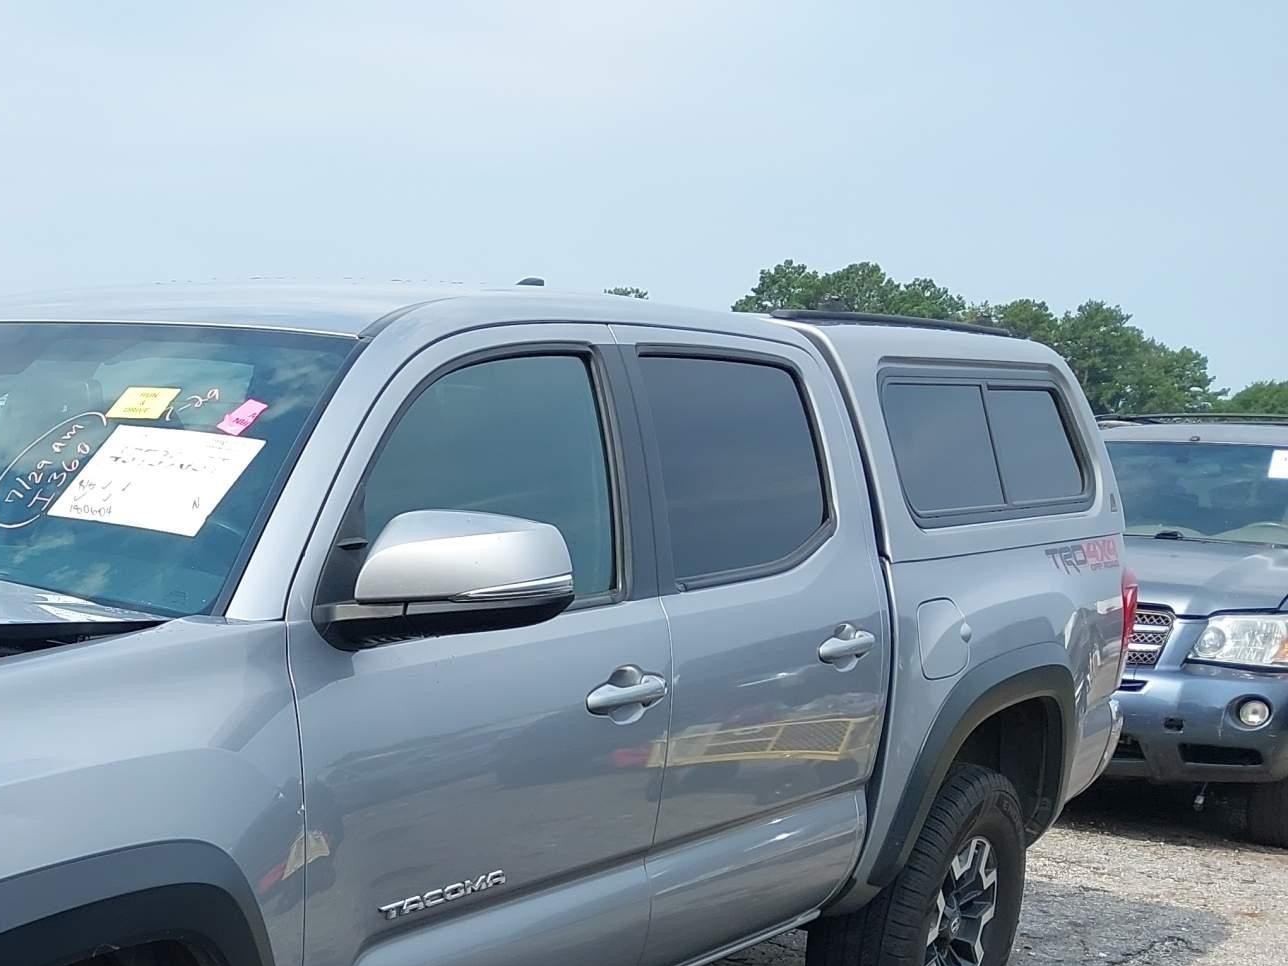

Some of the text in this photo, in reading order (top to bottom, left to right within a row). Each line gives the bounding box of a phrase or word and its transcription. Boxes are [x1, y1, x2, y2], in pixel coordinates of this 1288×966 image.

[4, 459, 53, 503] 7/29
[1044, 543, 1087, 576] TRD
[377, 869, 507, 920] TACOMA
